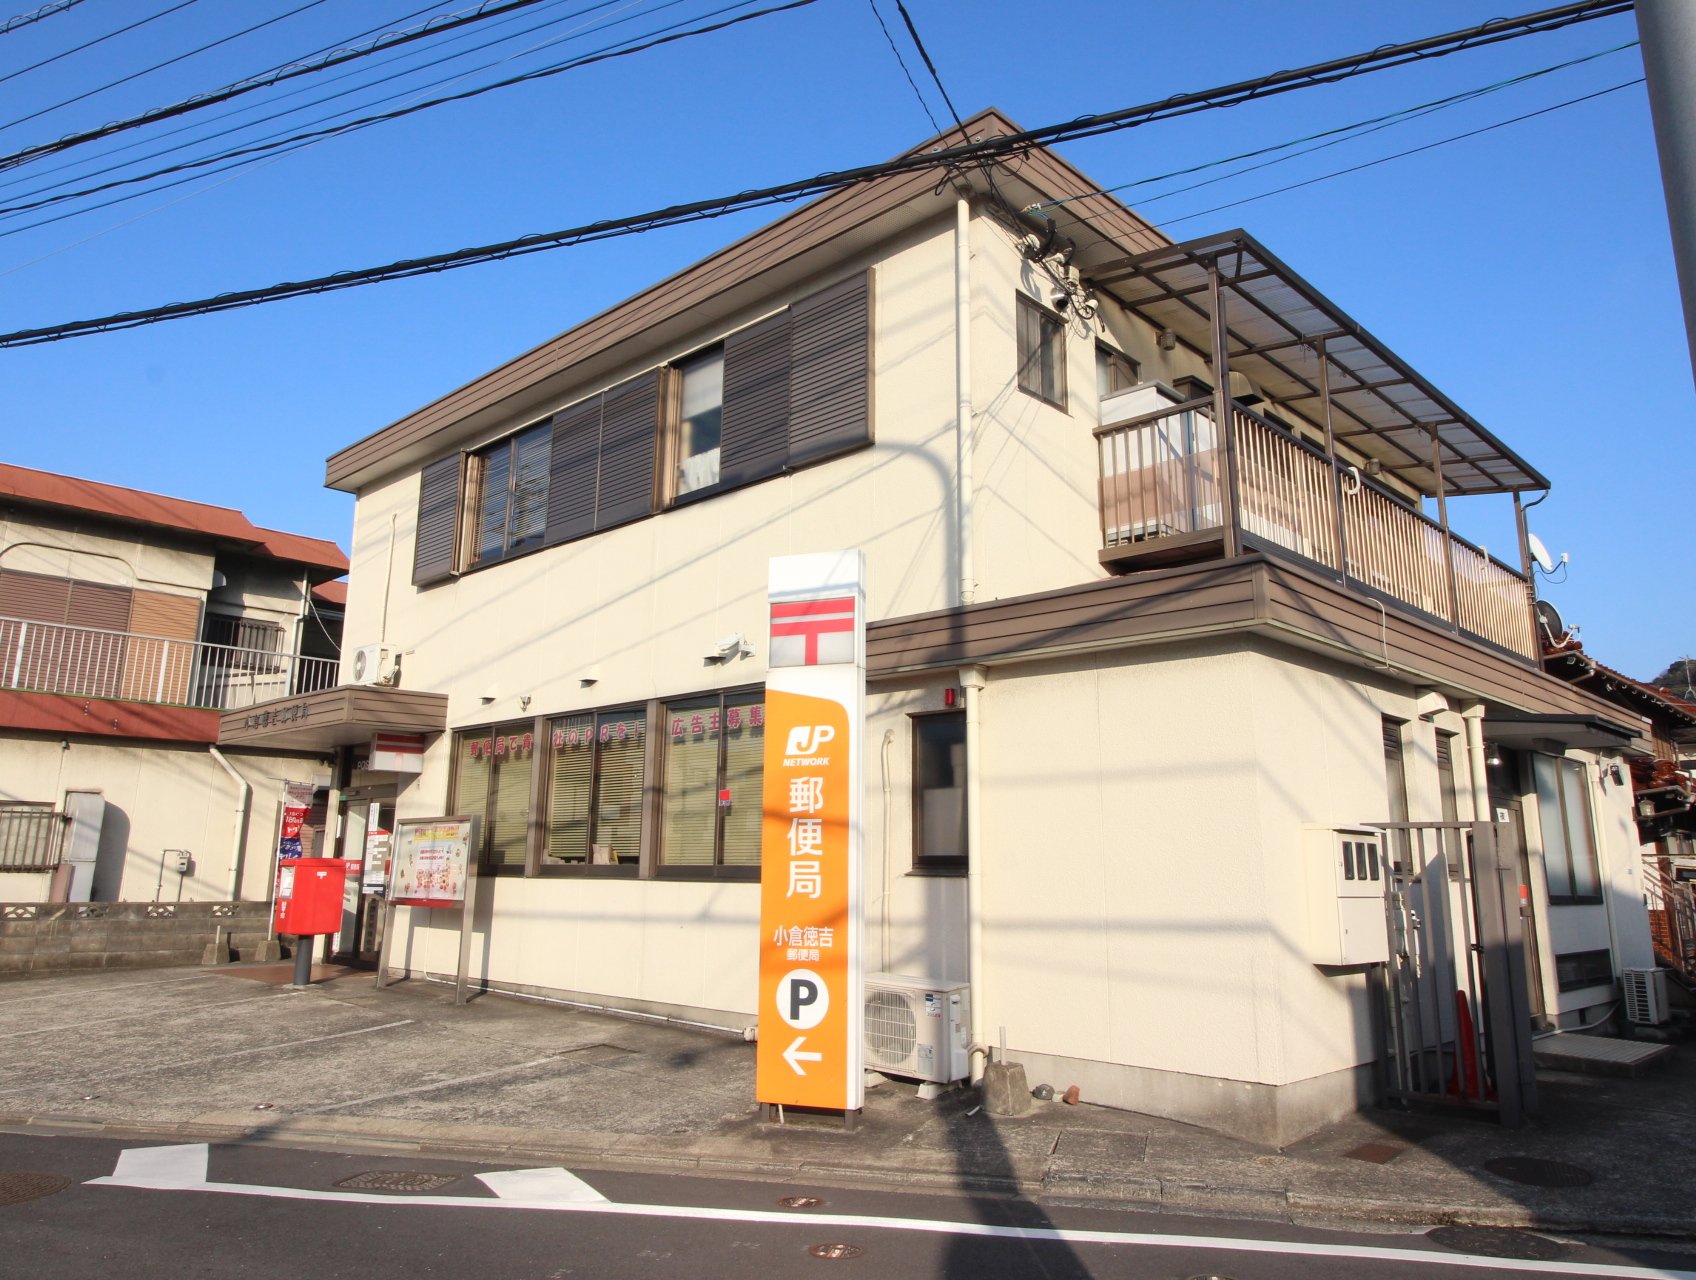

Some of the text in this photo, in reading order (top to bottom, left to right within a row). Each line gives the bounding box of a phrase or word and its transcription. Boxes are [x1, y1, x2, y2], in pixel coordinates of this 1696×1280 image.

[671, 705, 764, 737] 広告主募集
[785, 725, 834, 755] JP
[783, 757, 830, 767] NETWORK
[786, 776, 824, 899] 郵便局
[773, 925, 834, 948] 小倉徳吉
[786, 949, 820, 962] 郵便局
[790, 978, 818, 1021] P
